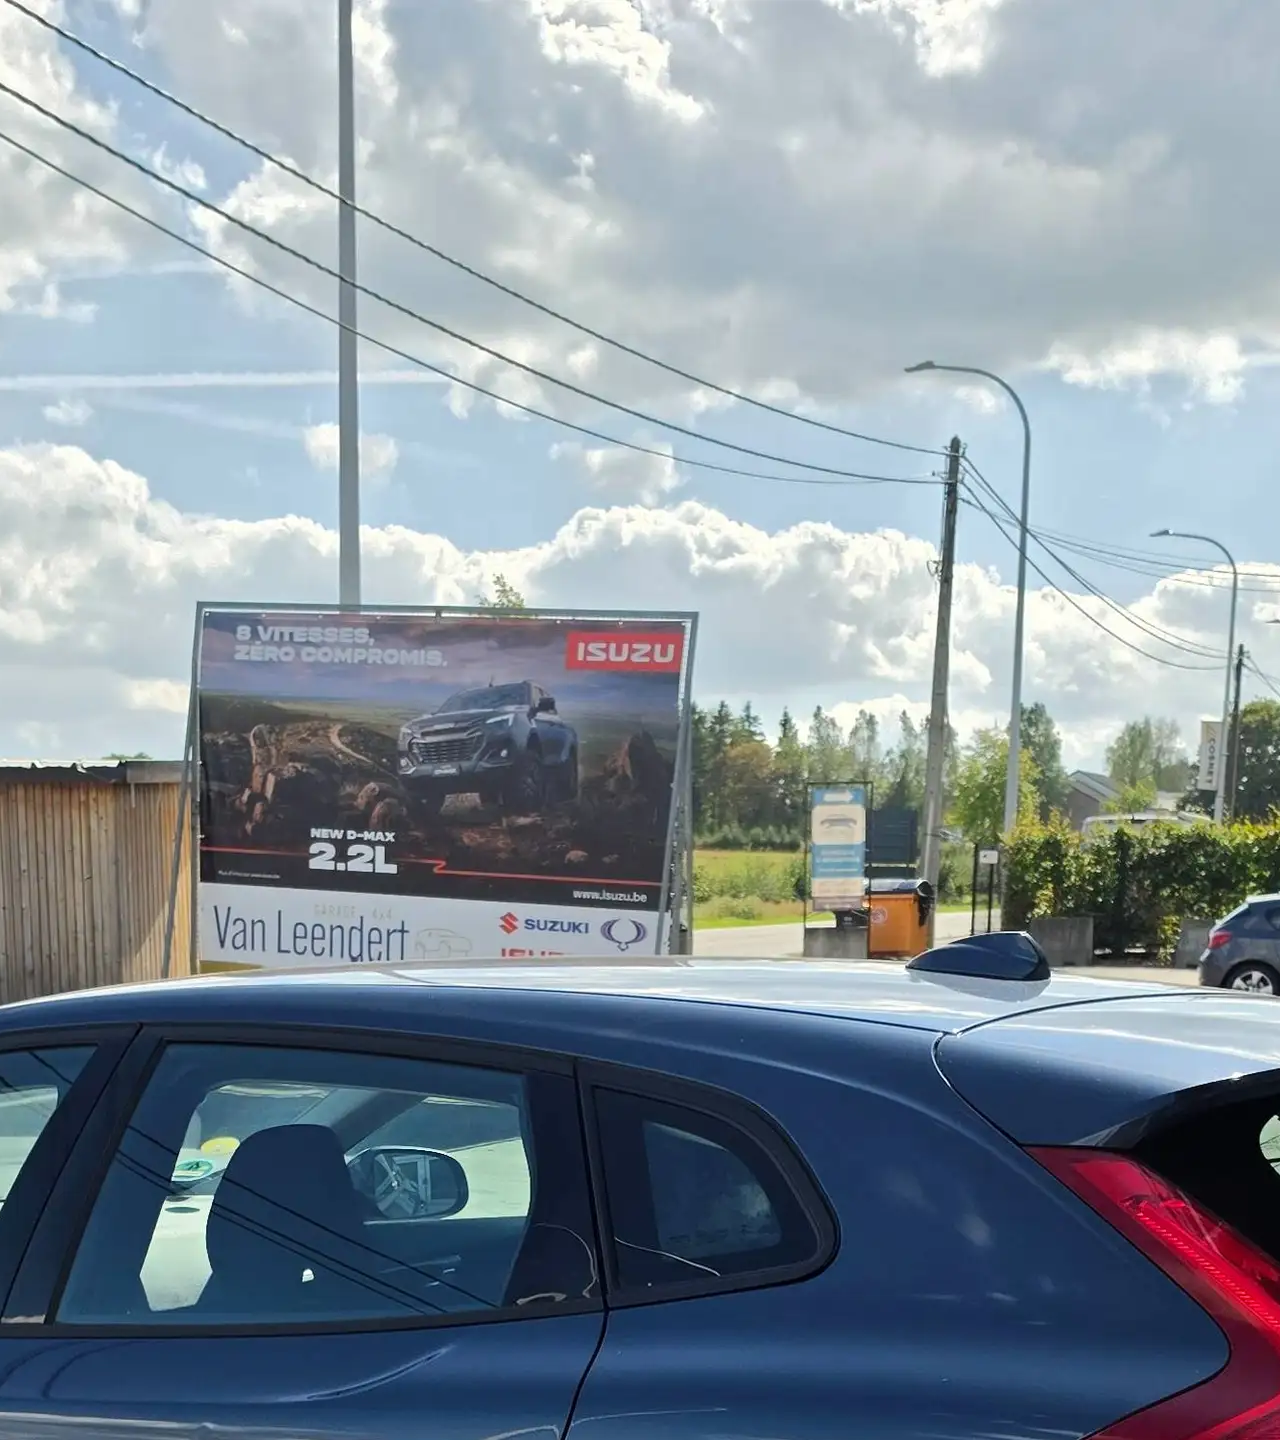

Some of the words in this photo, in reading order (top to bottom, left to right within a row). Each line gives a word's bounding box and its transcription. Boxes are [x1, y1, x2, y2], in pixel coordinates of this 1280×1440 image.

[236, 625, 251, 641] 8
[257, 626, 375, 646] VITESSES,
[300, 647, 448, 667] COMPROMIS.
[577, 642, 675, 663] ISUZU
[310, 828, 344, 840] NEW
[347, 829, 396, 842] D-MAX
[308, 842, 398, 874] 2.2L
[573, 889, 648, 902] www.isuzu.be
[213, 905, 267, 952] Van
[277, 909, 410, 962] Leendert
[524, 918, 589, 934] SUZUKI
